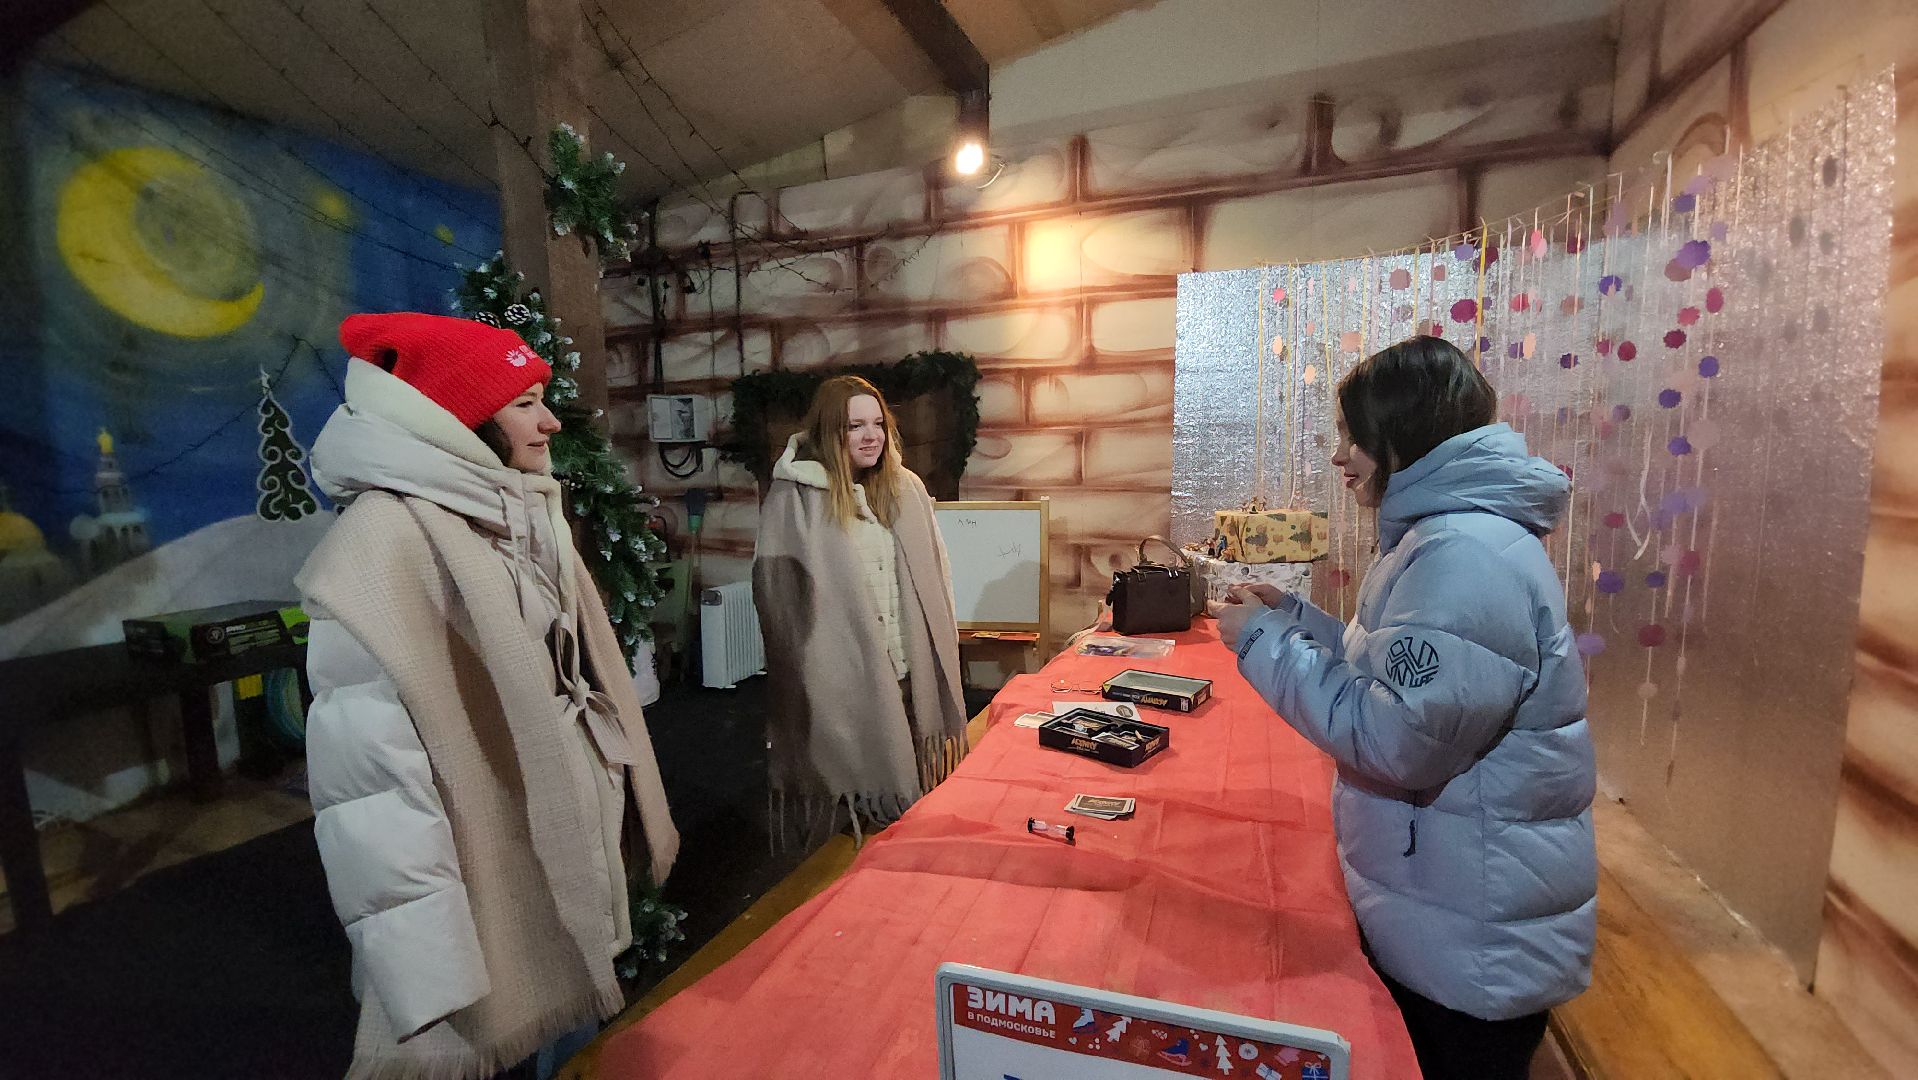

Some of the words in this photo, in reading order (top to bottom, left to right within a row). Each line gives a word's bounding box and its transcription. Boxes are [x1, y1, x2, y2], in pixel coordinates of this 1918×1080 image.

[966, 985, 1056, 1025] ЗИМА
[967, 1011, 974, 1020] В
[976, 1013, 1056, 1038] ПОДМОСКОВЬЕ
